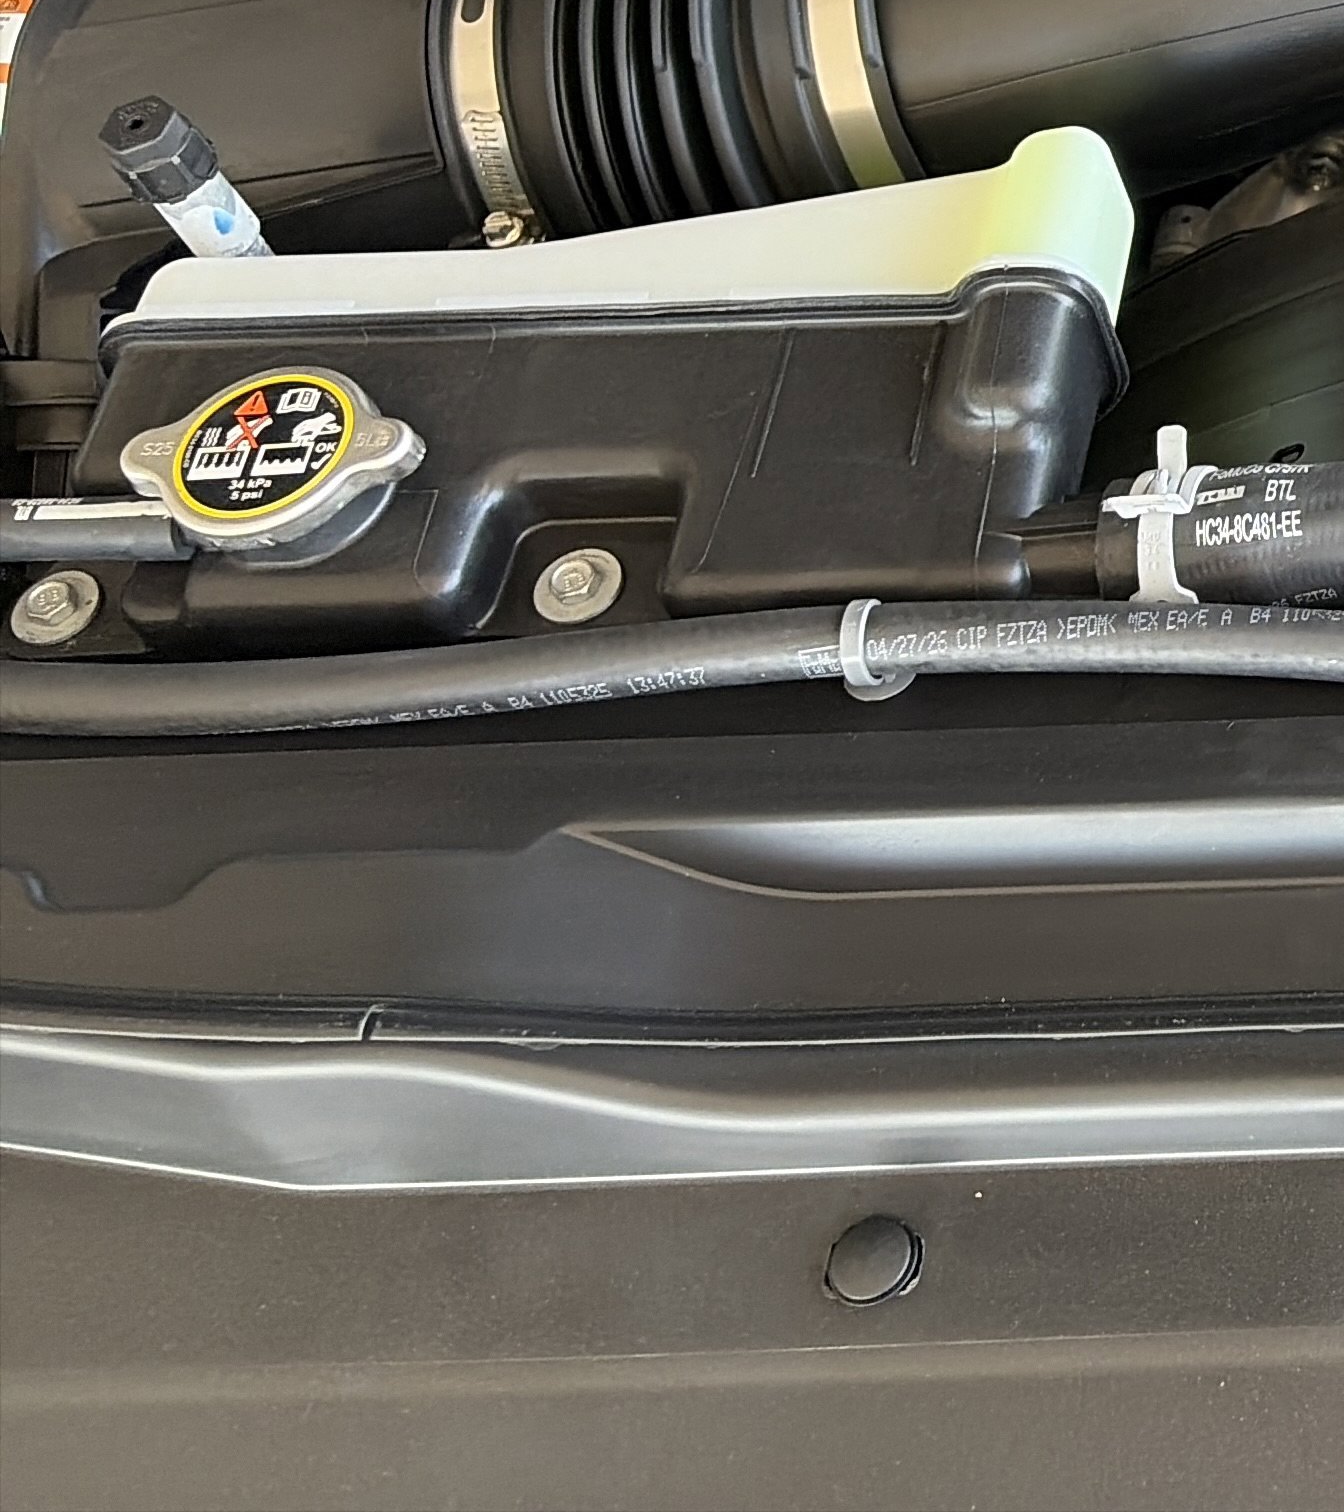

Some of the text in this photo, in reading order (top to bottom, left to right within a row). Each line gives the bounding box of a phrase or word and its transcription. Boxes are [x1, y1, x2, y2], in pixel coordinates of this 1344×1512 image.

[140, 441, 175, 456] S25
[315, 440, 337, 453] OK
[227, 476, 272, 490] 34 kPa
[1264, 479, 1297, 502] BTL
[229, 488, 263, 501] 5 psi
[1195, 509, 1303, 548] HC34-8C481-EE
[865, 630, 949, 663] 04/27/26
[956, 625, 988, 651] CIP
[1128, 609, 1160, 633] MEX
[1165, 608, 1208, 631] EA/E
[1220, 608, 1233, 625] A
[1249, 608, 1272, 625] B4
[625, 666, 707, 696] 13:47:37
